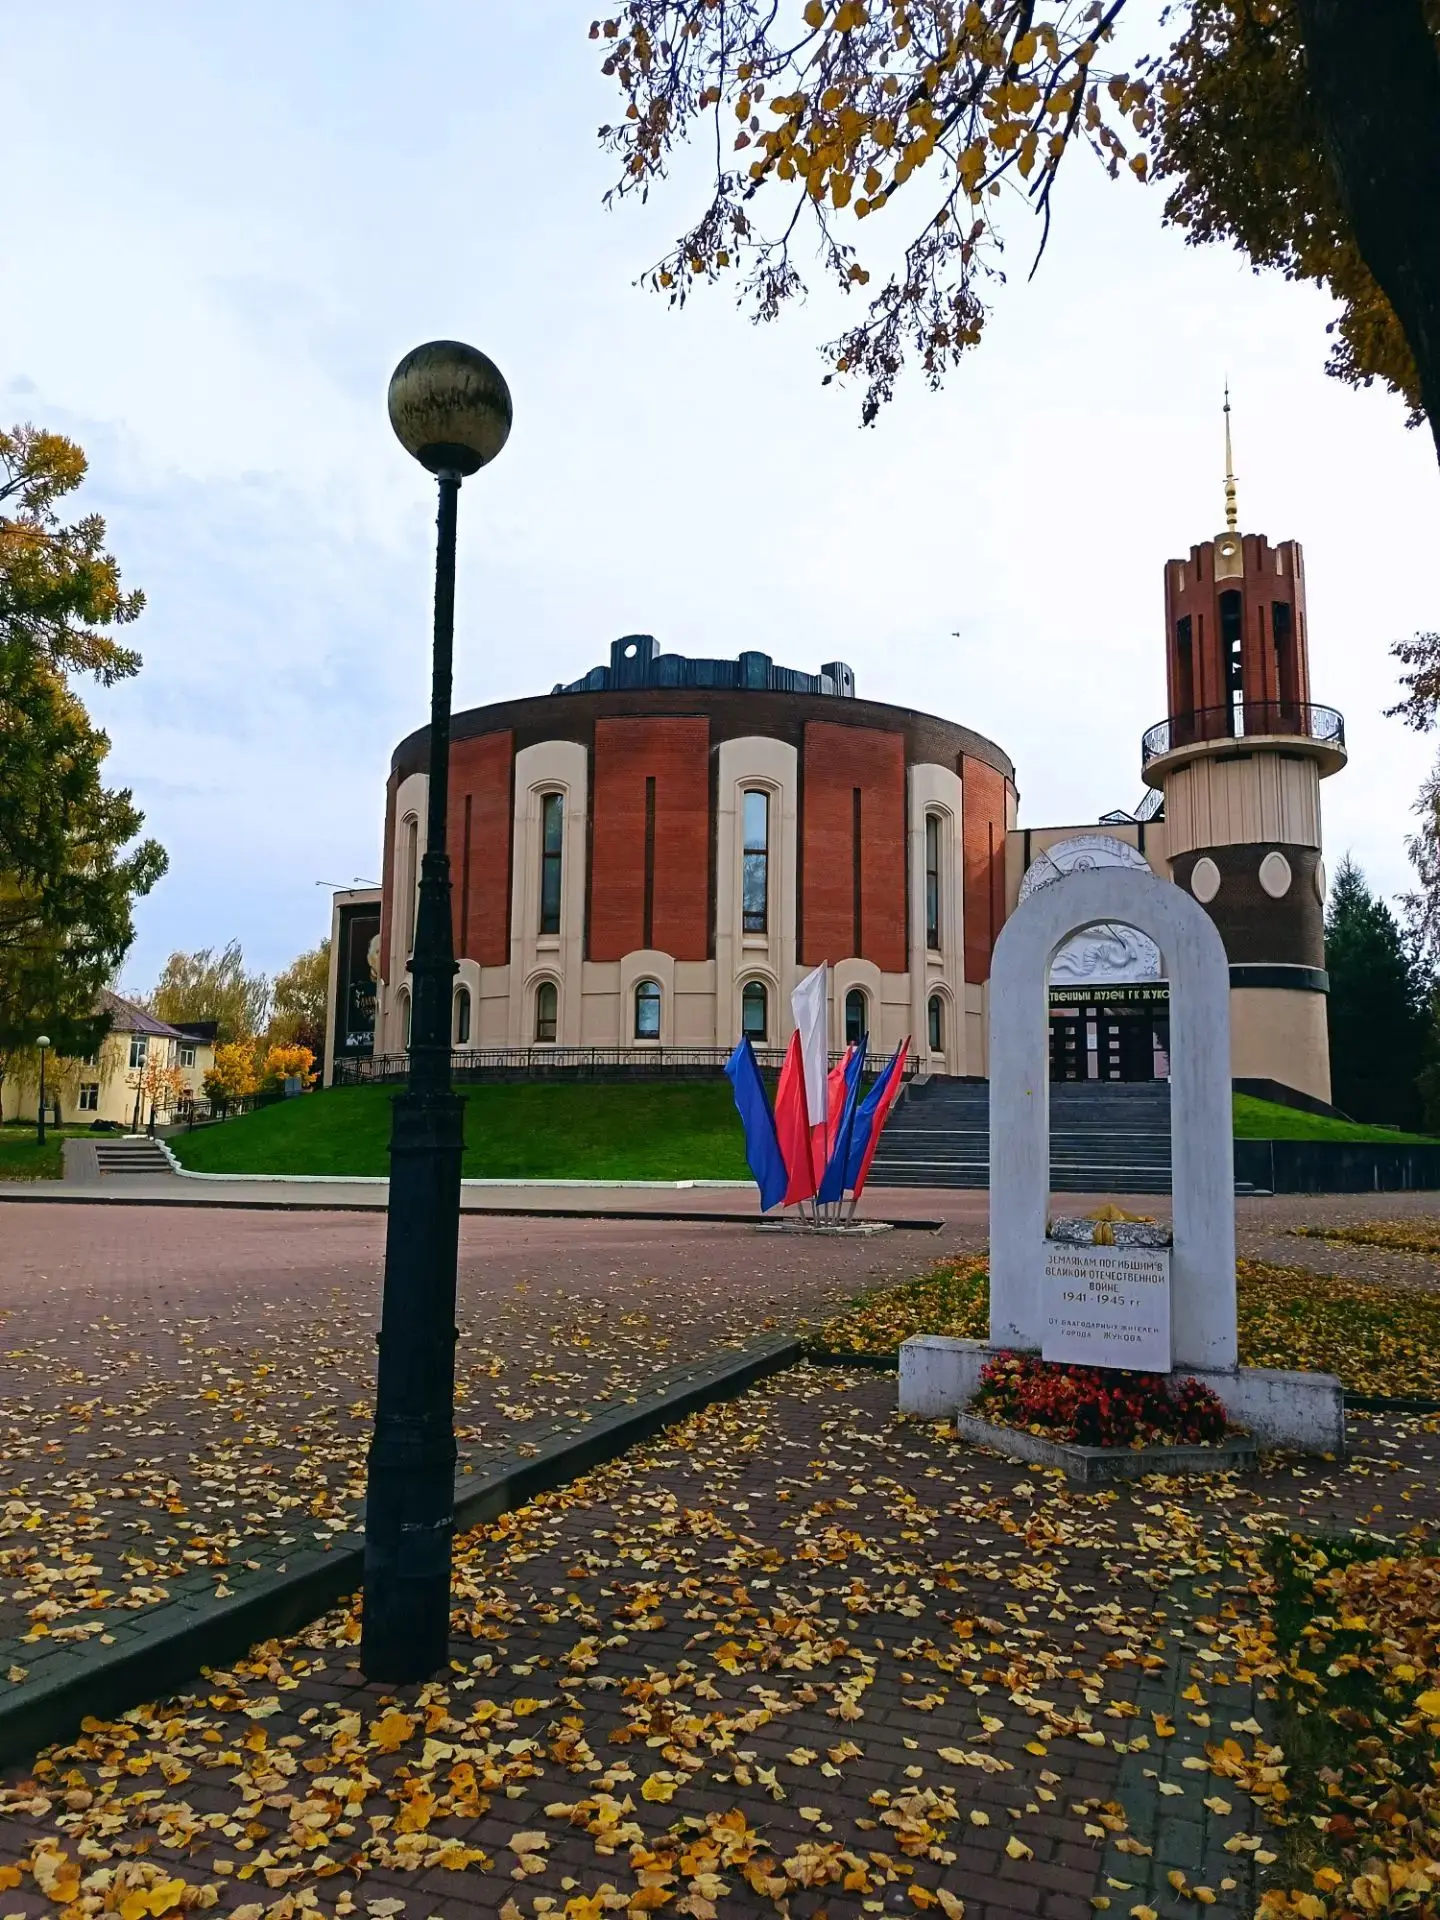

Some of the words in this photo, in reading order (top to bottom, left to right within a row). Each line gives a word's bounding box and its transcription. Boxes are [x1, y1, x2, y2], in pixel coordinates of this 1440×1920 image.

[1048, 992, 1091, 1002] ТВЕННЫЙ
[1047, 1254, 1096, 1267] ЗЕМЛЯКАМ
[1099, 1258, 1154, 1271] ПОГИБШИМ
[1157, 1262, 1163, 1272] В
[1045, 1266, 1086, 1278] ВЕЛИКОЙ
[1089, 1269, 1165, 1284] ОТЕЧЕСТВЕННОЙ
[1089, 1282, 1119, 1292] ВОЙНЕ
[1063, 1292, 1087, 1303] 1941
[1097, 1294, 1125, 1306] 1945
[1048, 1317, 1058, 1325] ОТ
[1103, 1331, 1142, 1342] ЖУКОВА
